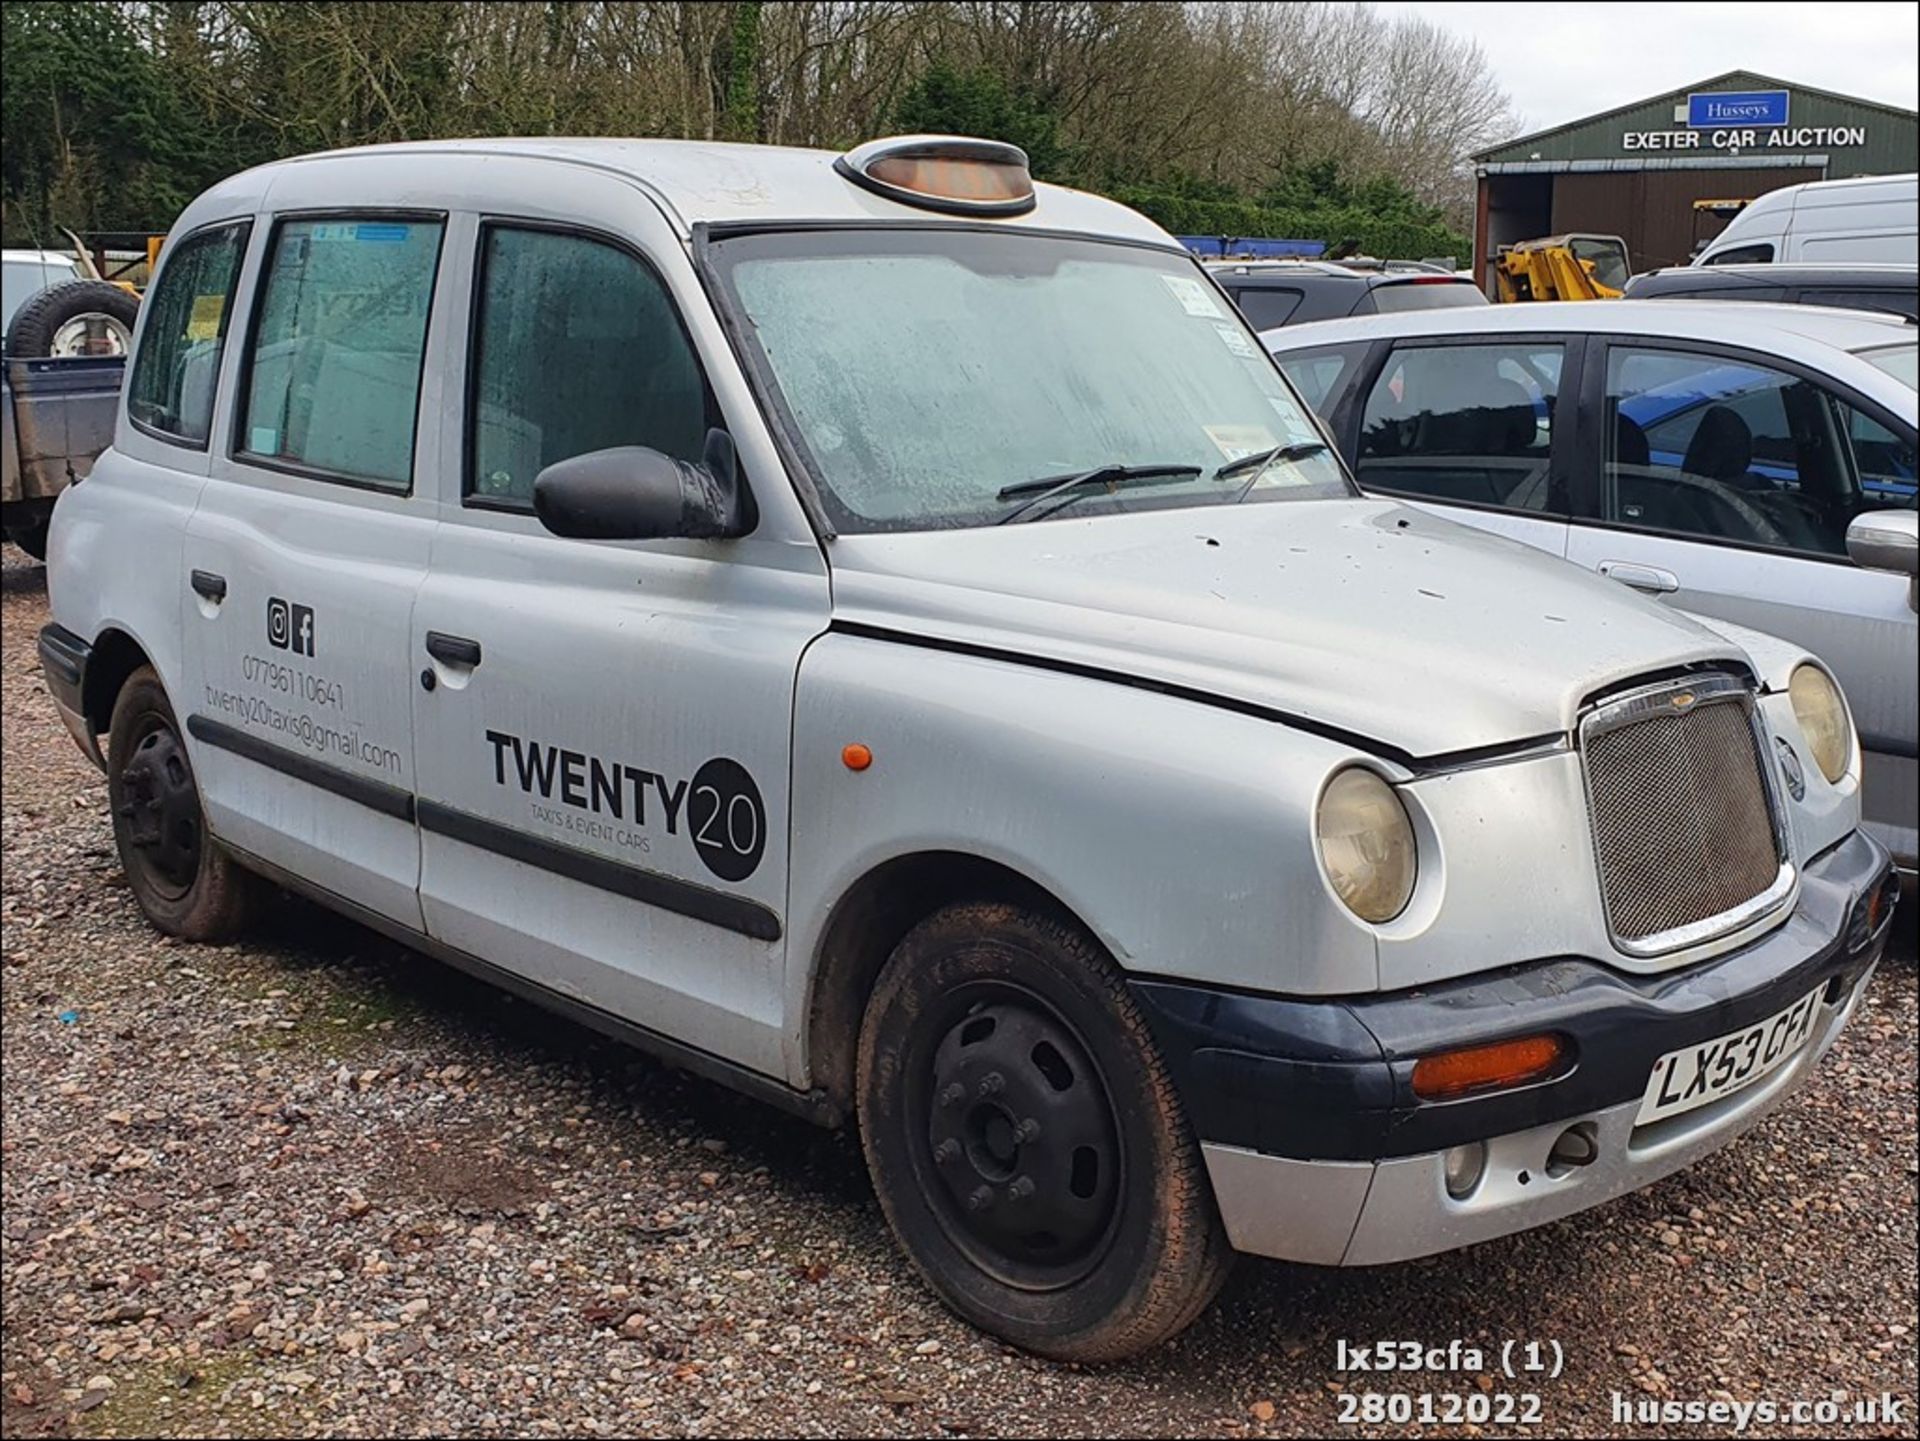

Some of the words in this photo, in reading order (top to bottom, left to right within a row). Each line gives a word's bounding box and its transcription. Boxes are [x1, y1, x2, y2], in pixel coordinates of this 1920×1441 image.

[1706, 102, 1769, 119] Husseys
[1623, 131, 1700, 150] EXETER
[1712, 130, 1755, 147] CAR
[1768, 127, 1866, 146] AUCTION
[242, 654, 344, 711] 07796110641
[205, 685, 402, 774] twenty20taxis@gmail.com
[576, 816, 613, 842] EVENT
[616, 829, 651, 854] CARS
